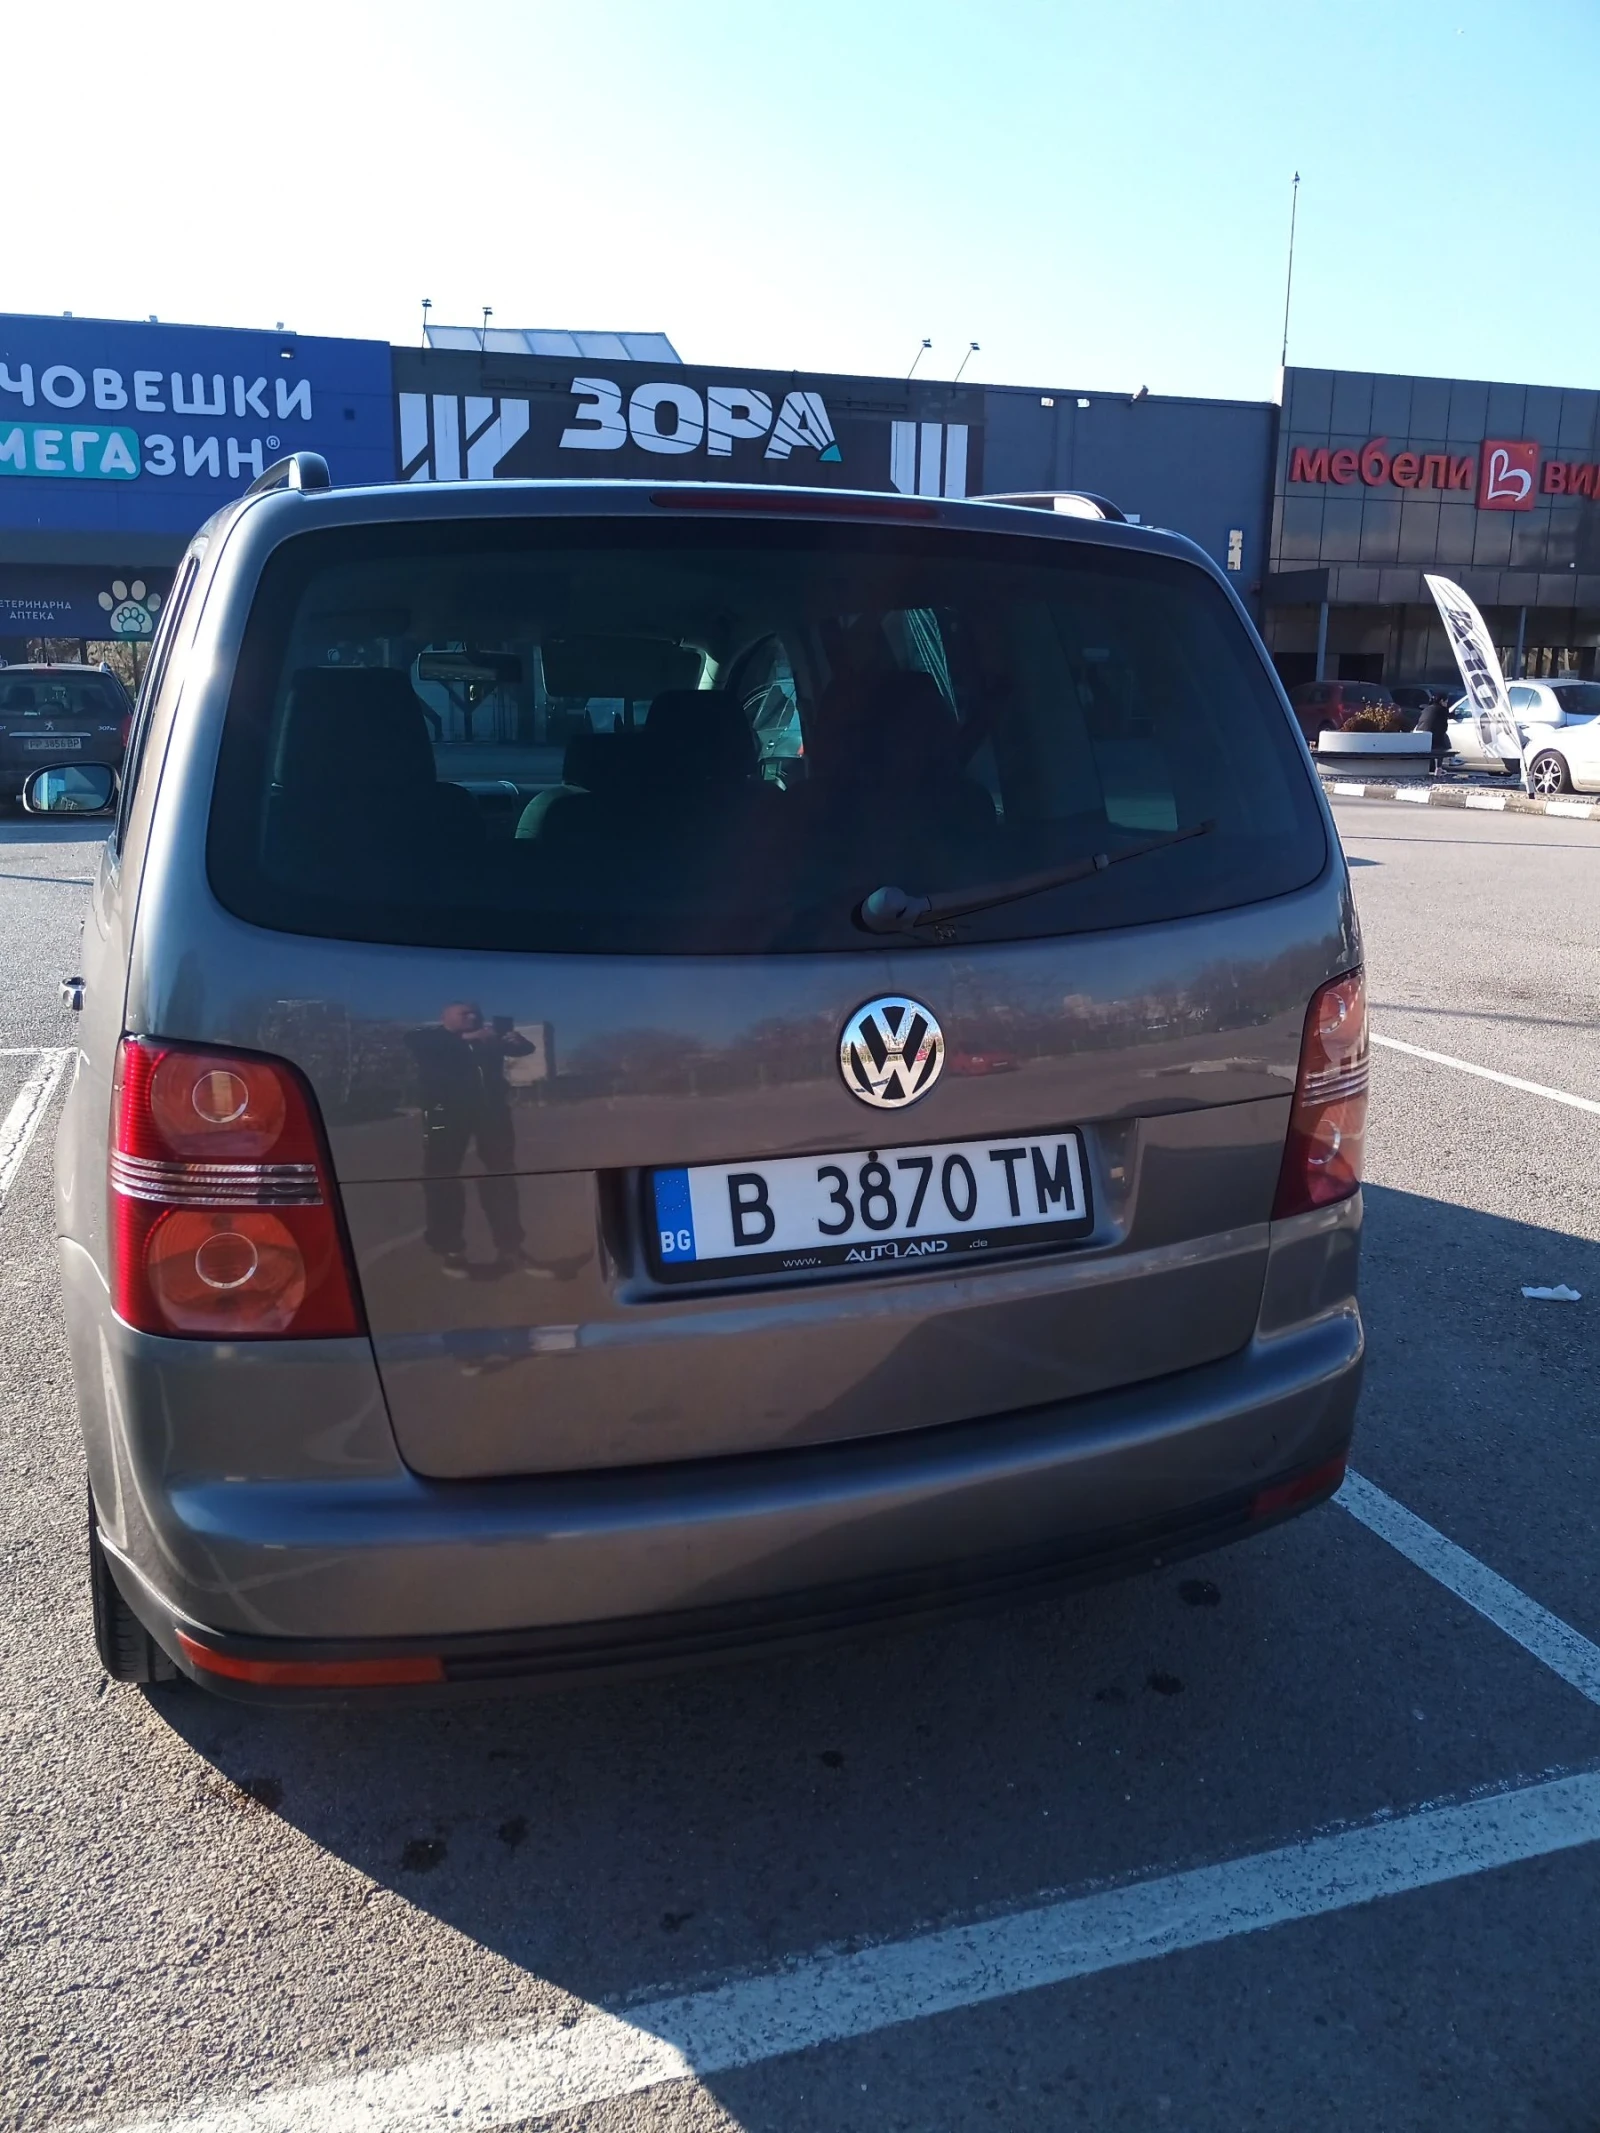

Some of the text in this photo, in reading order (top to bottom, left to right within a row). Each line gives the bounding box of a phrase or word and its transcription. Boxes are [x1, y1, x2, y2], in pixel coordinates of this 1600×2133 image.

[559, 377, 842, 462] ЗОРА
[1290, 437, 1474, 490] мебели
[9, 610, 55, 620] АПТЕКА
[727, 1144, 1076, 1247] B 3870 TM
[660, 1230, 692, 1253] BG
[782, 1257, 822, 1268] www.
[845, 1239, 948, 1262] AUTOLAND
